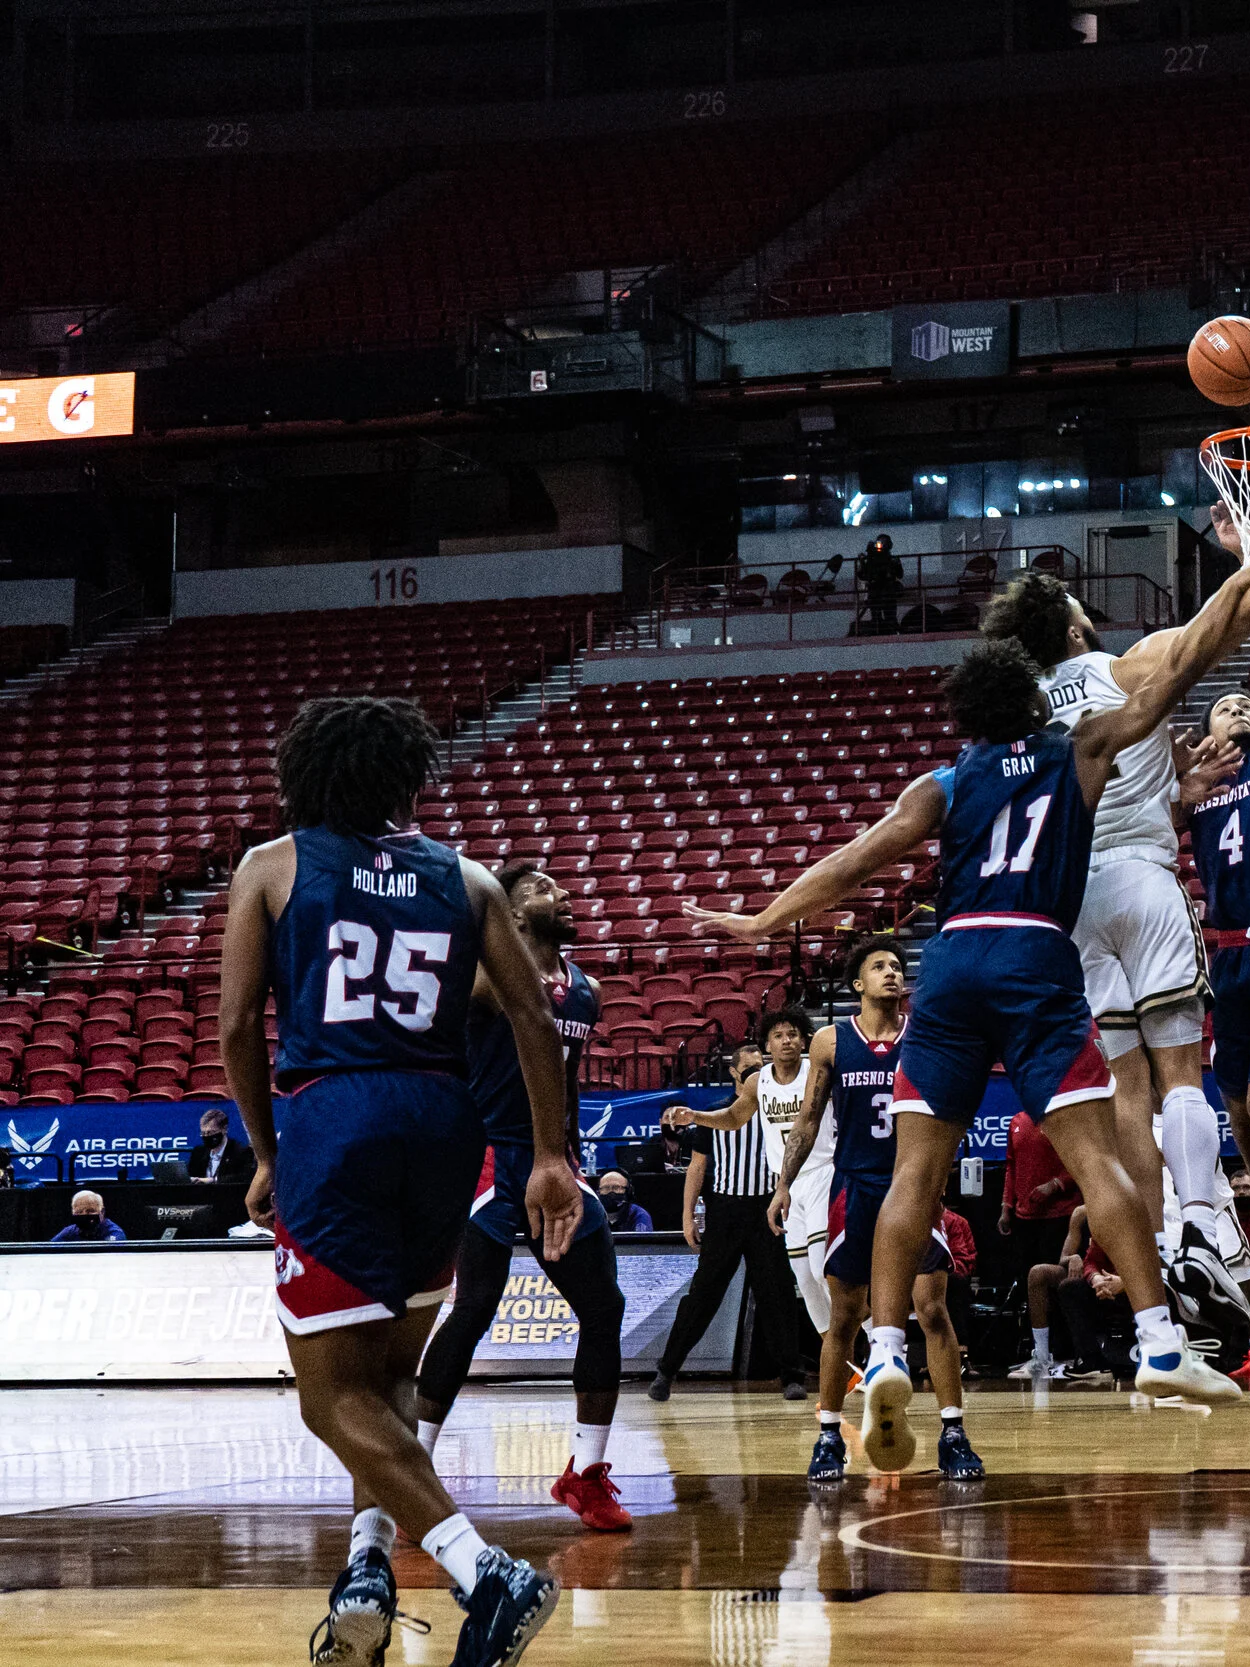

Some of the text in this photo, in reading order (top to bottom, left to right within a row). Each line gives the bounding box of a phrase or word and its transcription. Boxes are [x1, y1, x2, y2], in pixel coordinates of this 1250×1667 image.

[1163, 44, 1209, 73] 227
[684, 90, 726, 119] 226
[206, 122, 249, 148] 225
[951, 327, 993, 338] MOUNTAIN
[951, 337, 993, 353] WEST
[47, 377, 95, 434] G
[370, 566, 418, 601] 116
[1001, 755, 1036, 778] GRAY
[979, 793, 1052, 878] 11
[1218, 808, 1244, 866] 4
[352, 866, 418, 898] HOLLAND
[322, 919, 452, 1033] 25
[842, 1071, 884, 1087] FRESNO
[762, 1093, 803, 1116] Colorad
[870, 1093, 894, 1140] 3
[65, 1136, 189, 1154] AIR FORCE
[74, 1152, 180, 1169] RESERVE
[104, 1286, 212, 1342] BEEF
[497, 1299, 571, 1321] YOUR
[490, 1322, 580, 1345] BEEF?
